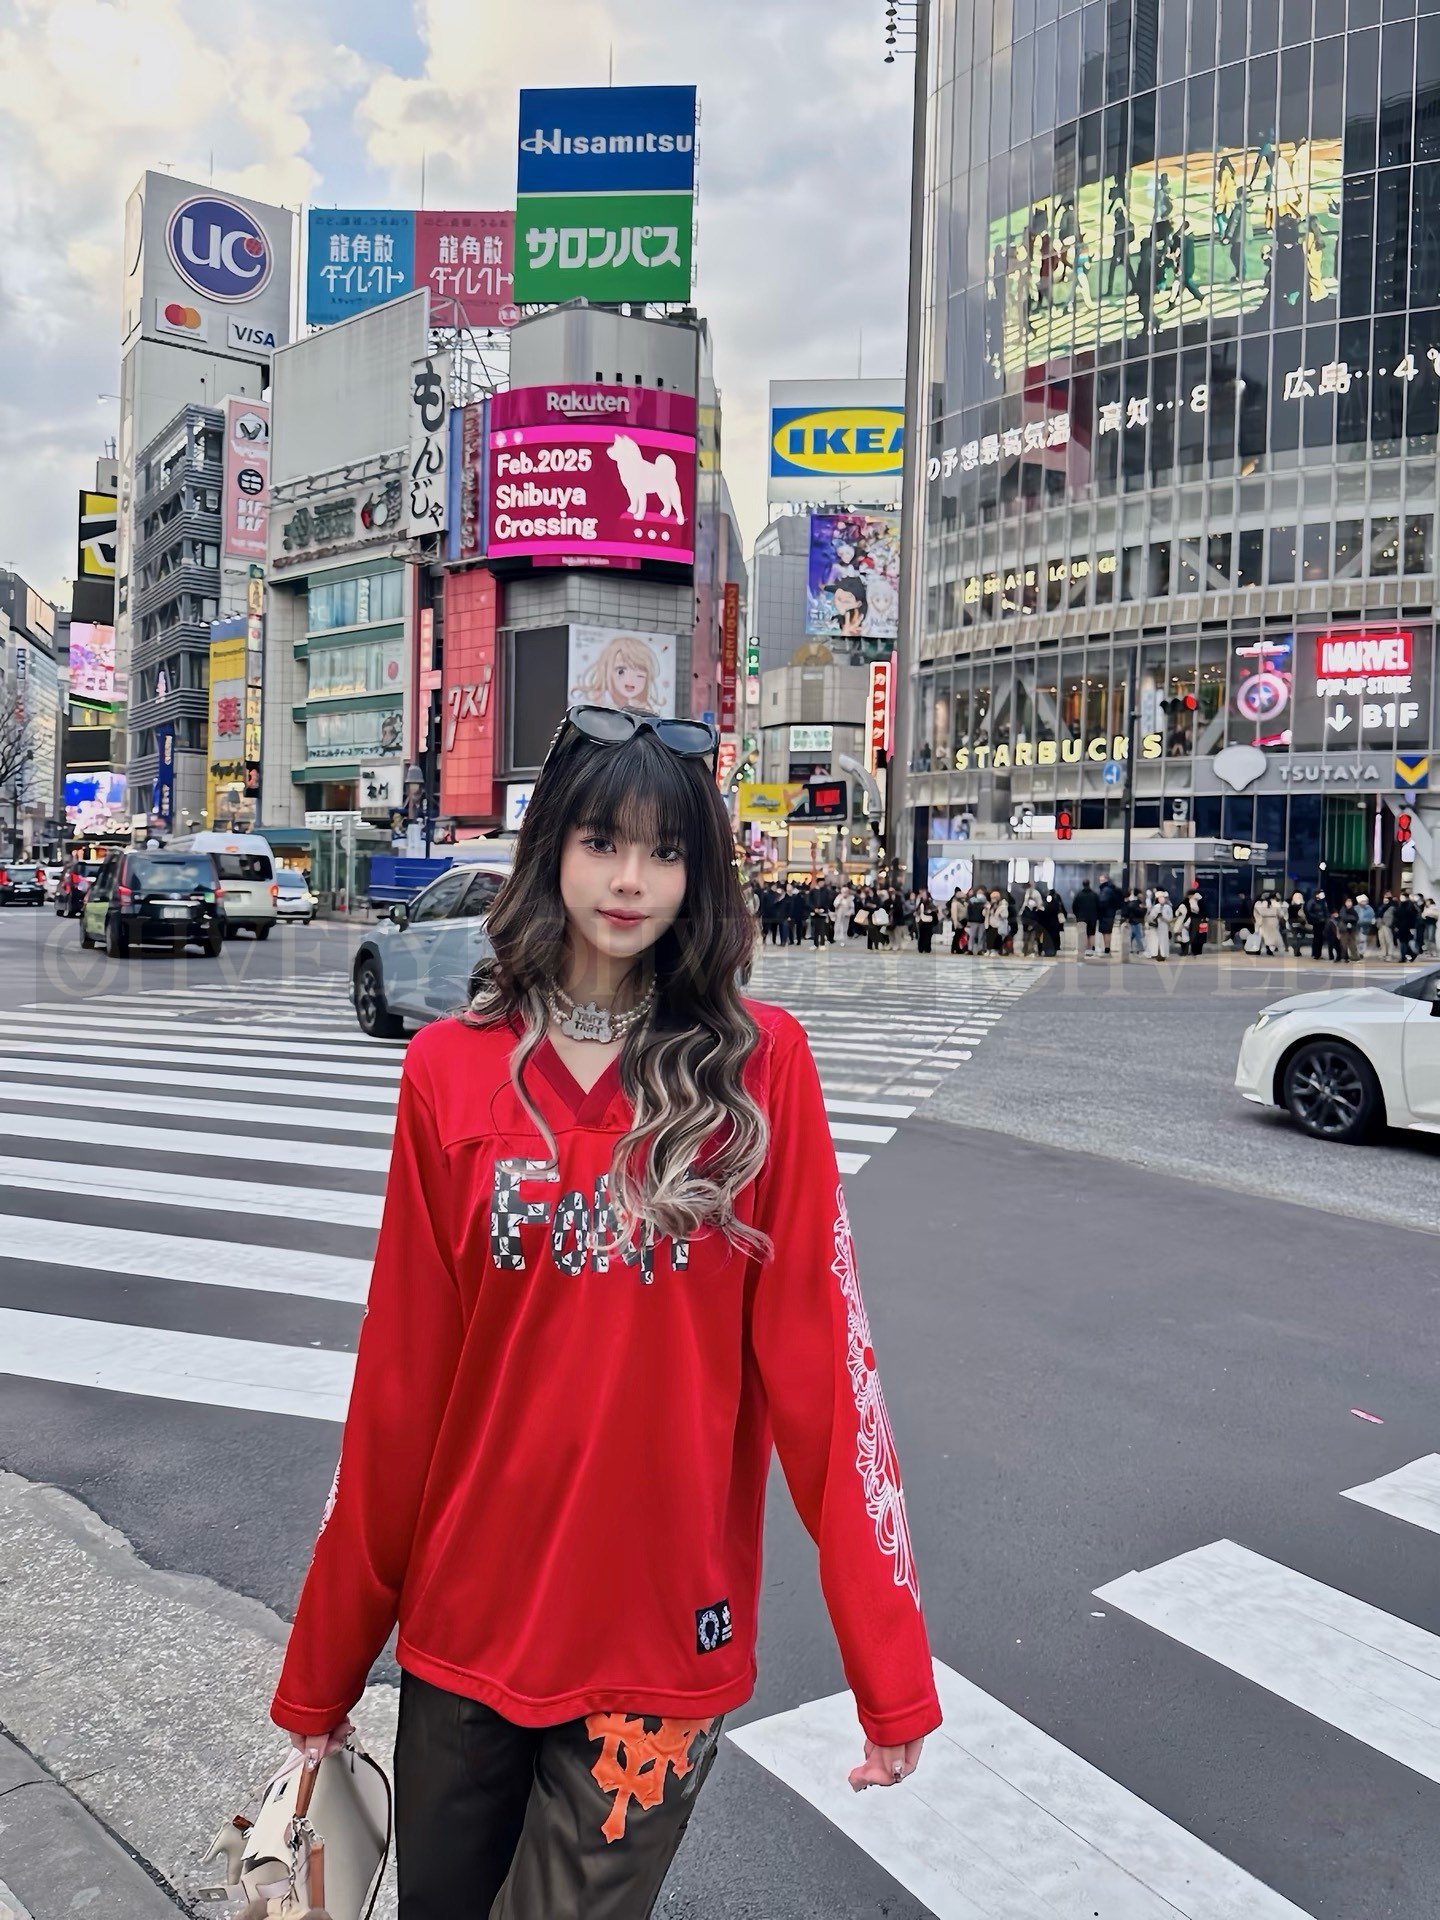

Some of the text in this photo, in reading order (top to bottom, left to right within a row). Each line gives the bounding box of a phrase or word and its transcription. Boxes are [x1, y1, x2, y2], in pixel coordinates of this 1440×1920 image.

[520, 128, 692, 155] Hisamitsu
[330, 233, 395, 263] 龍角散
[439, 234, 503, 264] 龍角散
[526, 226, 681, 269] サロンパス
[232, 323, 276, 348] VISA
[547, 390, 631, 415] Rakuten
[411, 359, 445, 528] もんじゃ
[497, 448, 593, 477] Feb.2025
[496, 482, 587, 510] Shibuya
[494, 510, 599, 540] Crossing
[1321, 638, 1410, 674] MARVEL
[1362, 702, 1420, 729] B1F
[955, 733, 1163, 771] STARBUCKS
[1279, 764, 1380, 782] TSUTAYA
